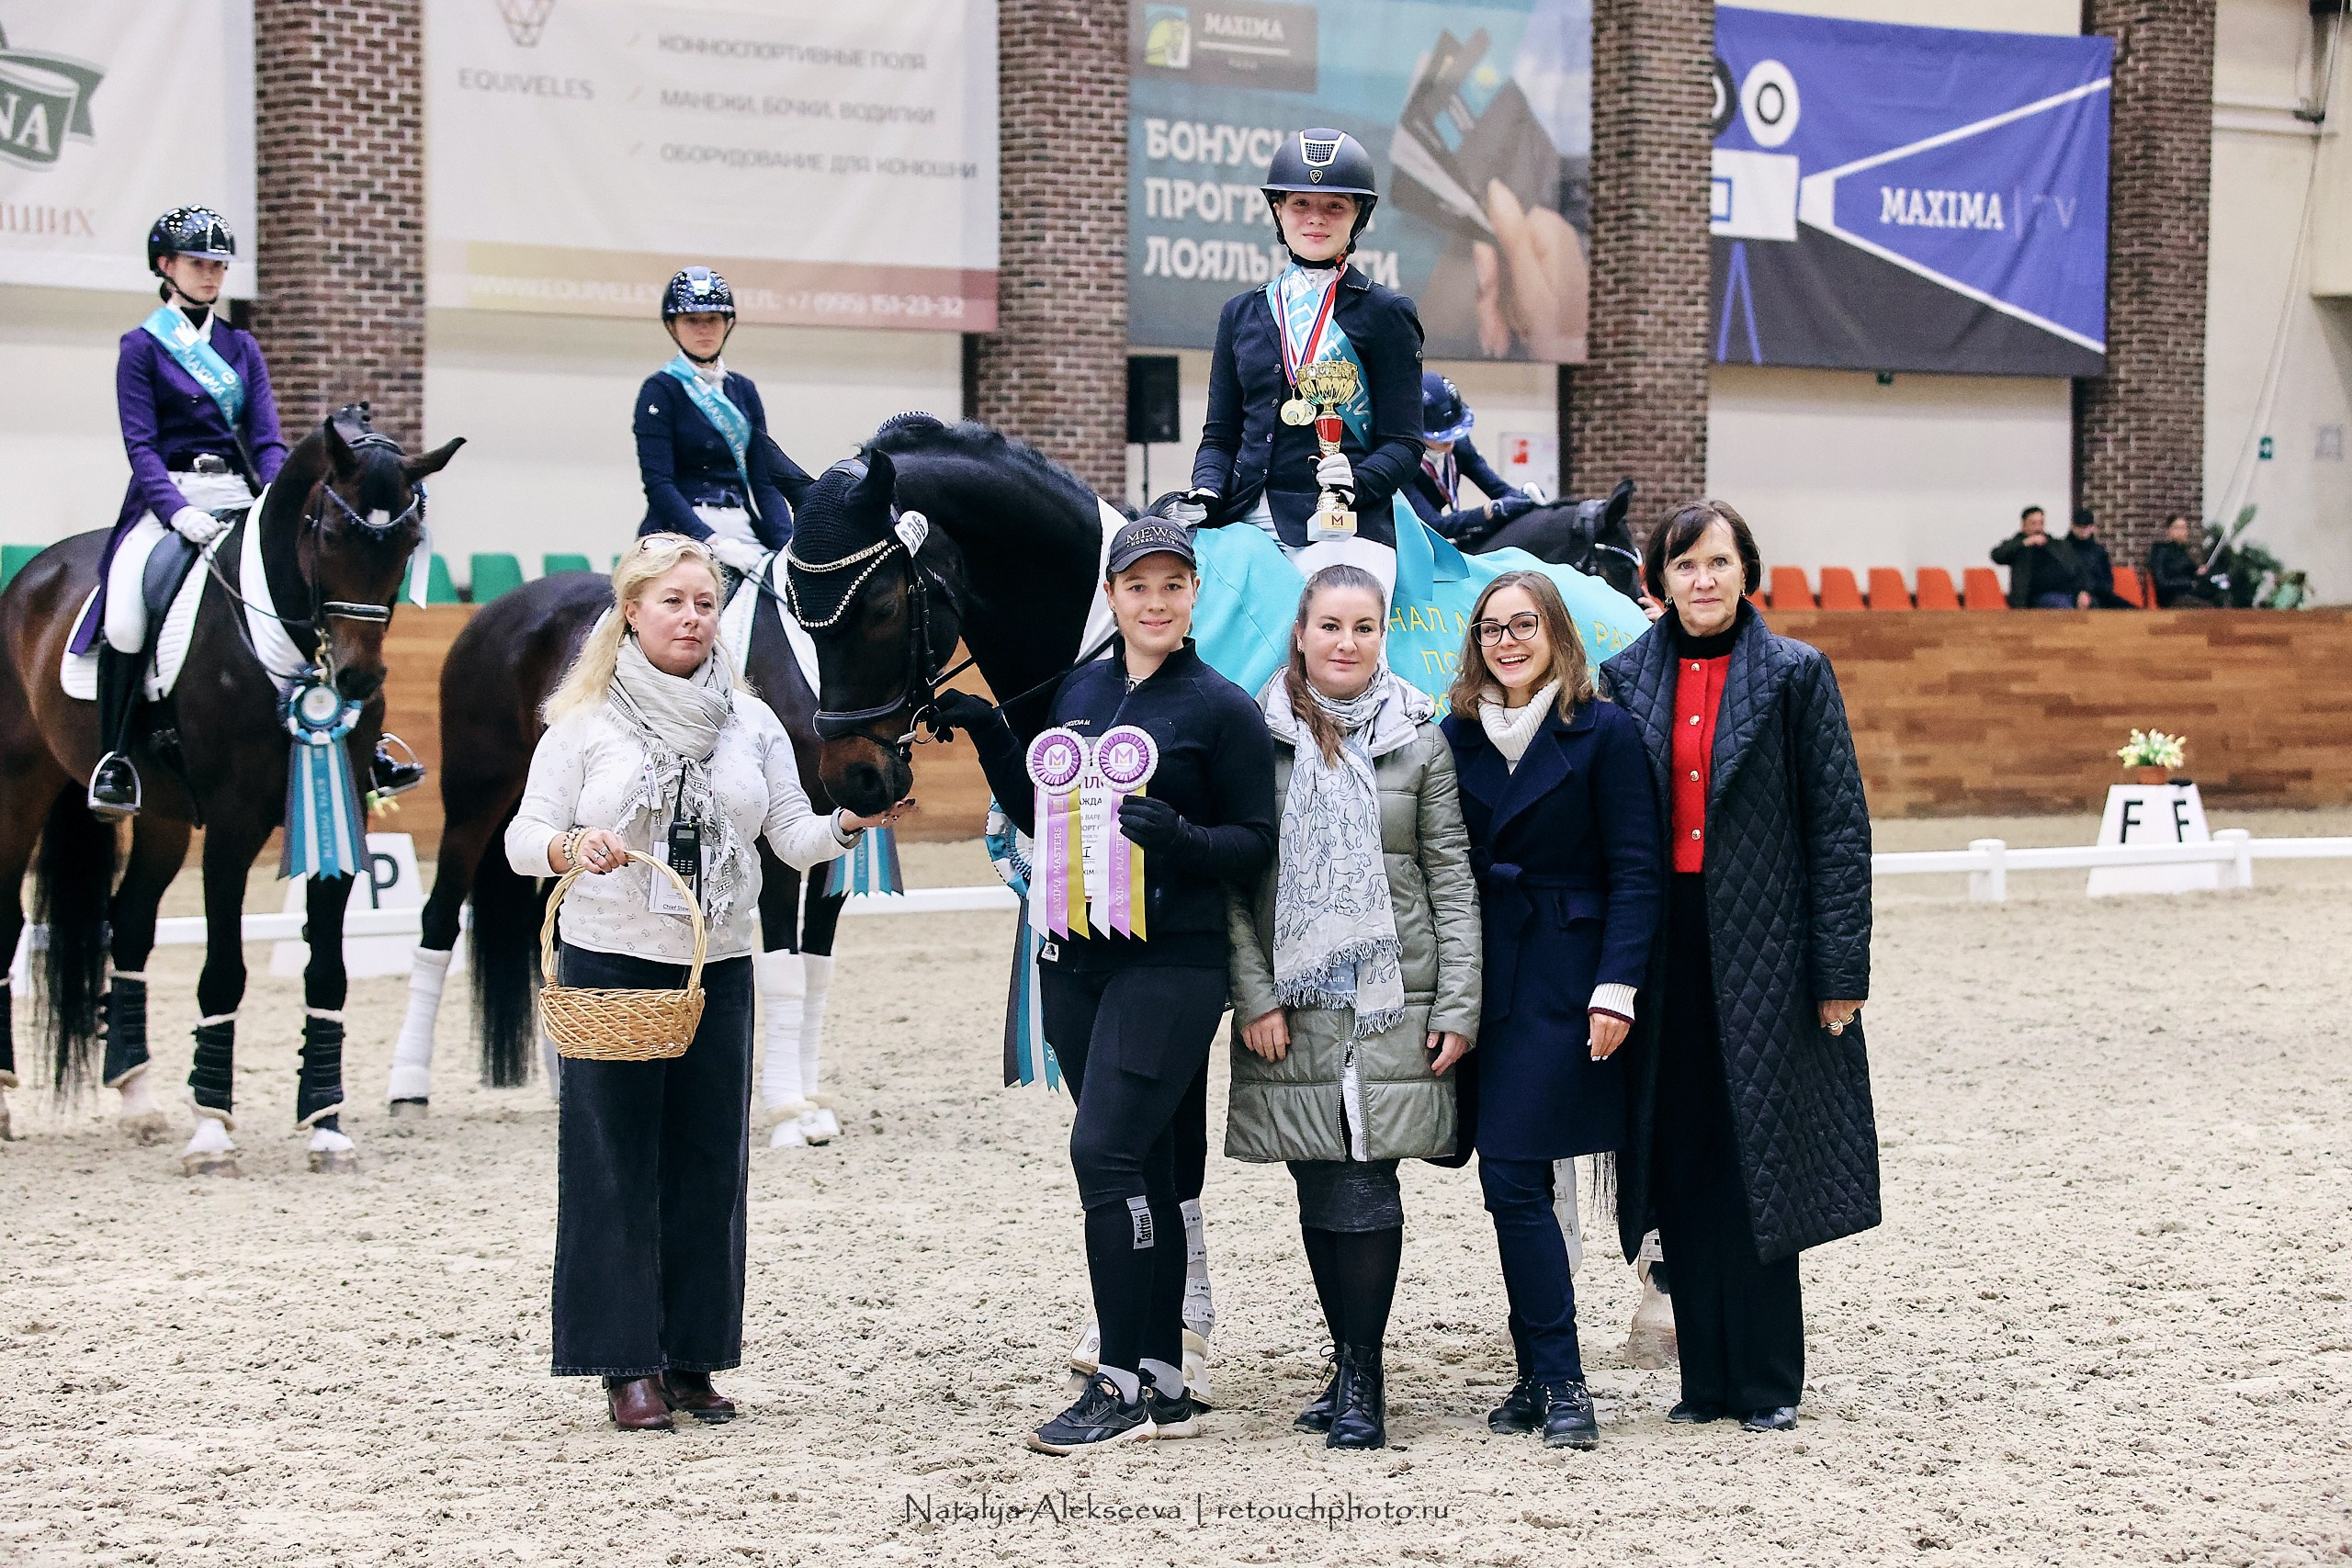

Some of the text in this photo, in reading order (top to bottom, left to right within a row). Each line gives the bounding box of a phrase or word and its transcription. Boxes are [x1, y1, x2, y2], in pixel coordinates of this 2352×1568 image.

[1204, 13, 1284, 41] MAXIMA
[871, 51, 926, 70] ПОЛЯ
[458, 68, 595, 100] EQUIVELES
[661, 142, 978, 180] ОБОРУДОВАНИЕ ДЛЯ КОНЮШНИ
[1880, 186, 2005, 230] MAXIMA
[1126, 525, 1179, 545] MEWS
[2120, 799, 2190, 844] F F
[1054, 827, 1062, 874] MASTERS
[1115, 874, 1124, 918] MAXIMA
[1135, 1213, 1153, 1244] Tattini
